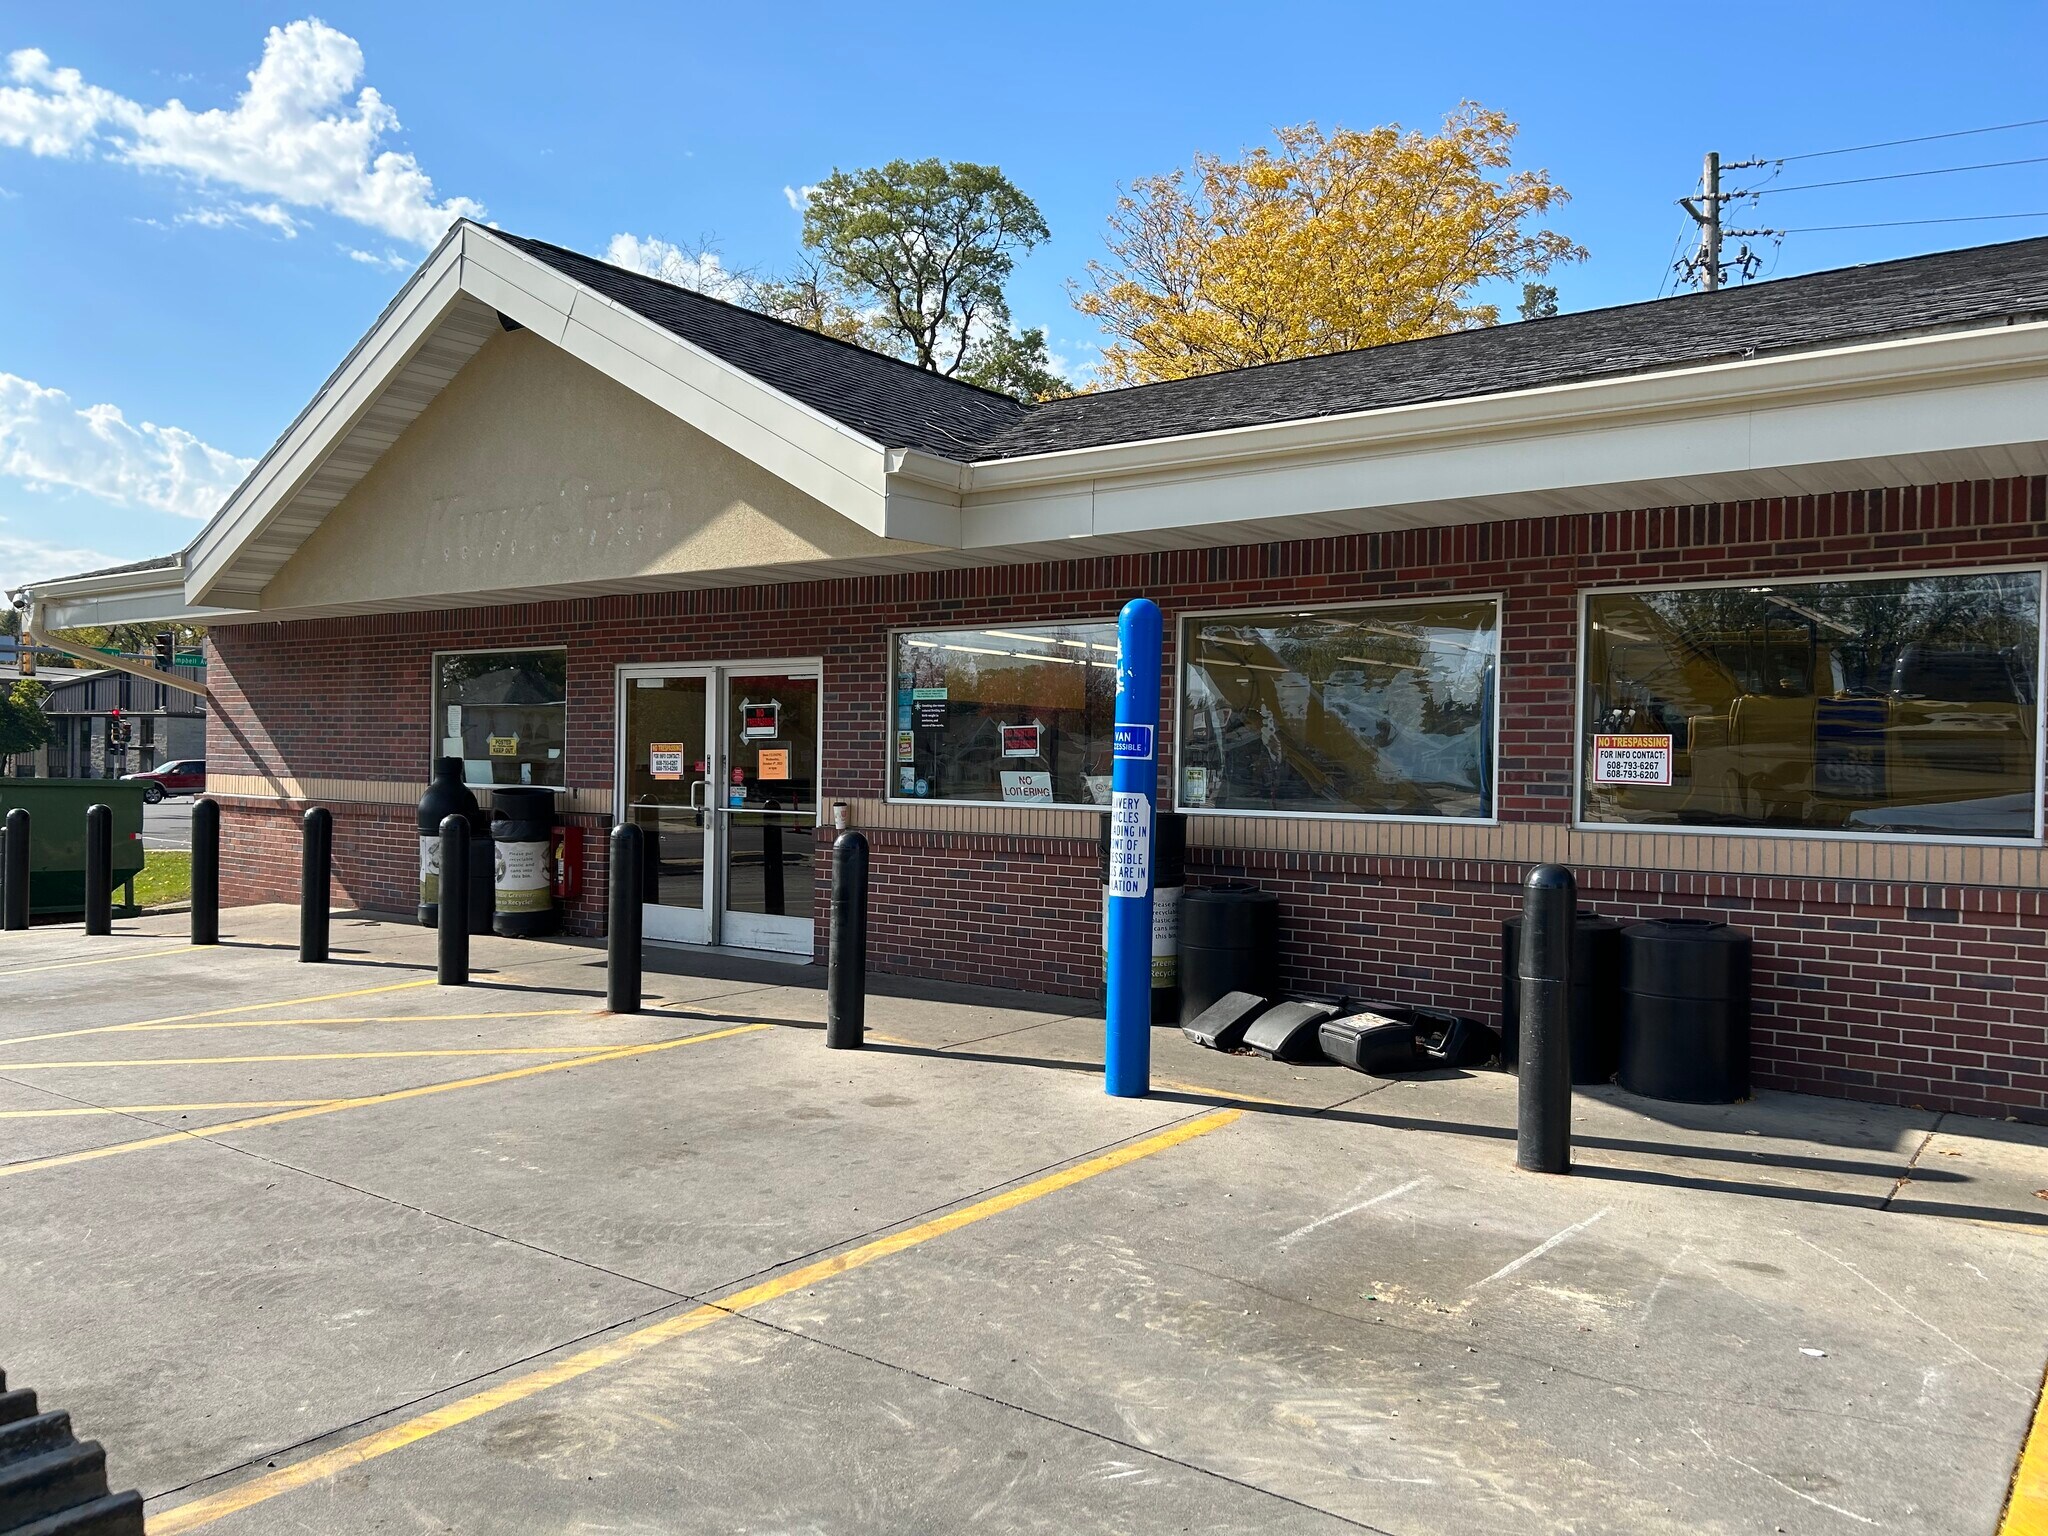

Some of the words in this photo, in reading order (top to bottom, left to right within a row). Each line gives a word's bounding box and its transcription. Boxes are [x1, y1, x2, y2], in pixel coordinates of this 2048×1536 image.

[1115, 731, 1131, 742] VAN
[1598, 737, 1610, 747] NO
[1613, 737, 1668, 748] TRESPASSING
[1600, 750, 1613, 759] FOR
[1615, 751, 1631, 759] INFO
[1632, 751, 1666, 760] CONTACT:
[1606, 761, 1659, 770] 608-793-6267
[1606, 770, 1659, 779] 608-793-6200
[1018, 776, 1032, 786] NO
[1004, 787, 1050, 797] LOITERING
[1138, 826, 1147, 837] IN
[1126, 839, 1139, 851] OF
[1119, 866, 1135, 878] ARE
[1138, 867, 1146, 878] IN
